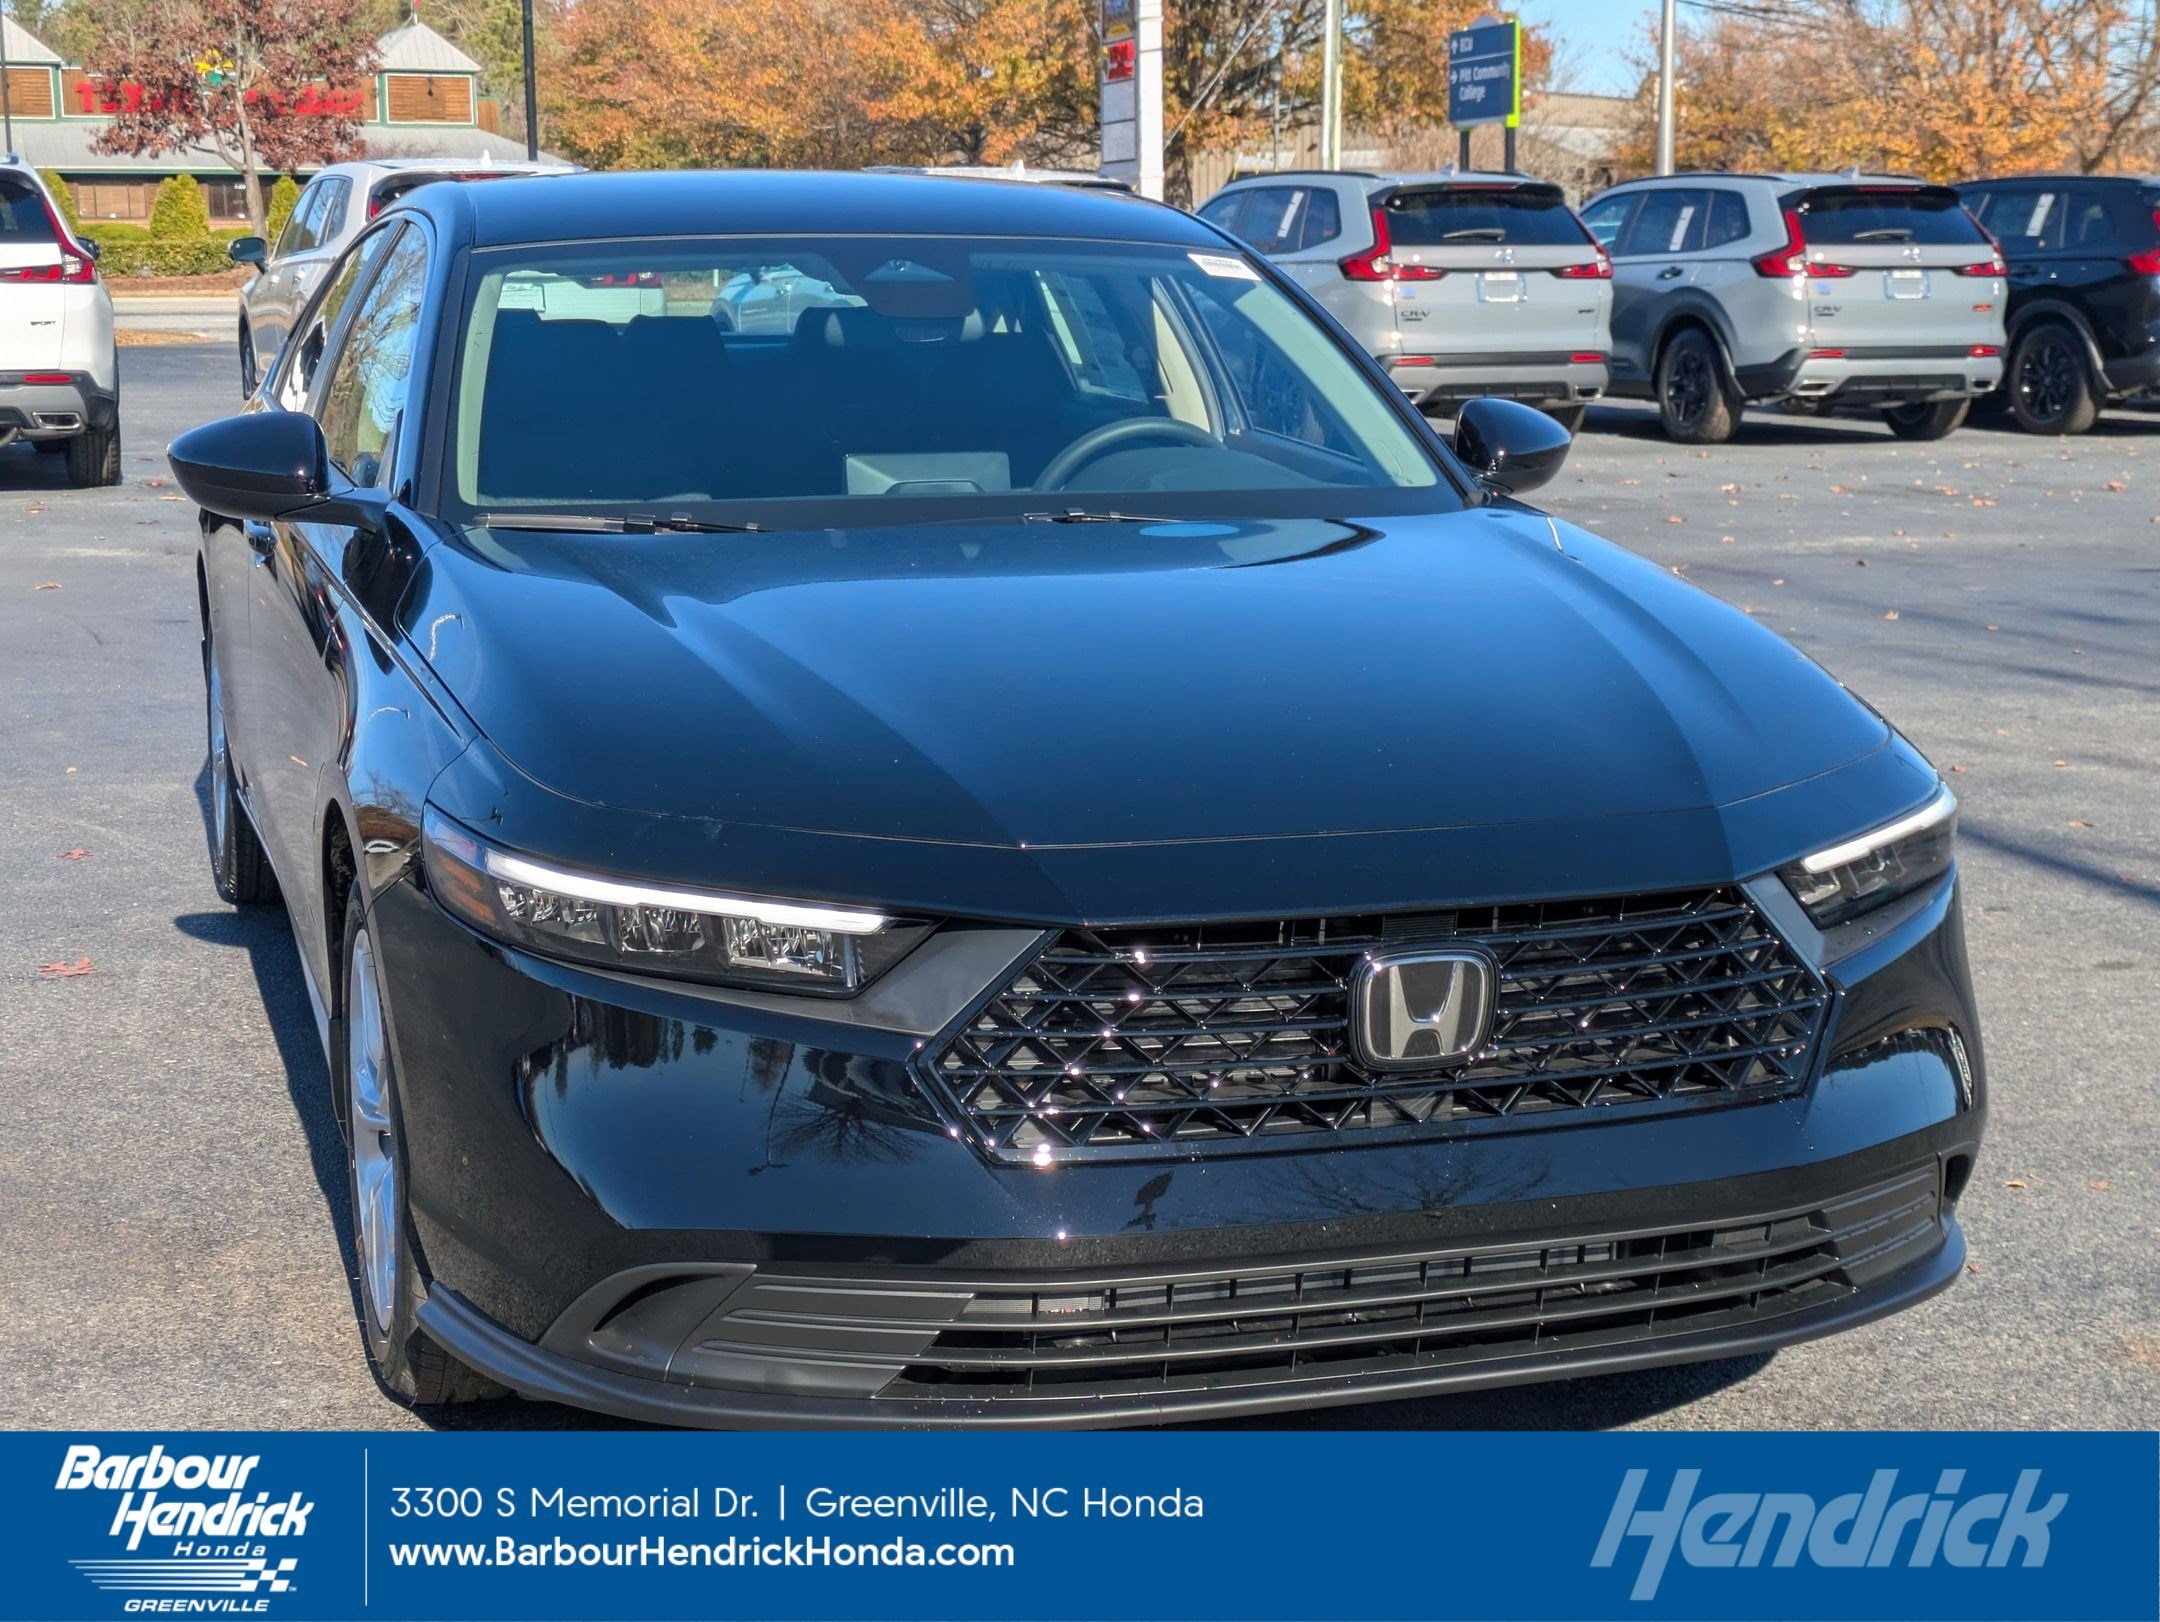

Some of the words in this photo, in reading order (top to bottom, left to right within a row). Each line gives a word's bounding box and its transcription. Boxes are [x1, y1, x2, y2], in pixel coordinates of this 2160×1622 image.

[1460, 67, 1472, 82] Pitt
[1473, 62, 1510, 80] Community
[1460, 85, 1486, 102] College
